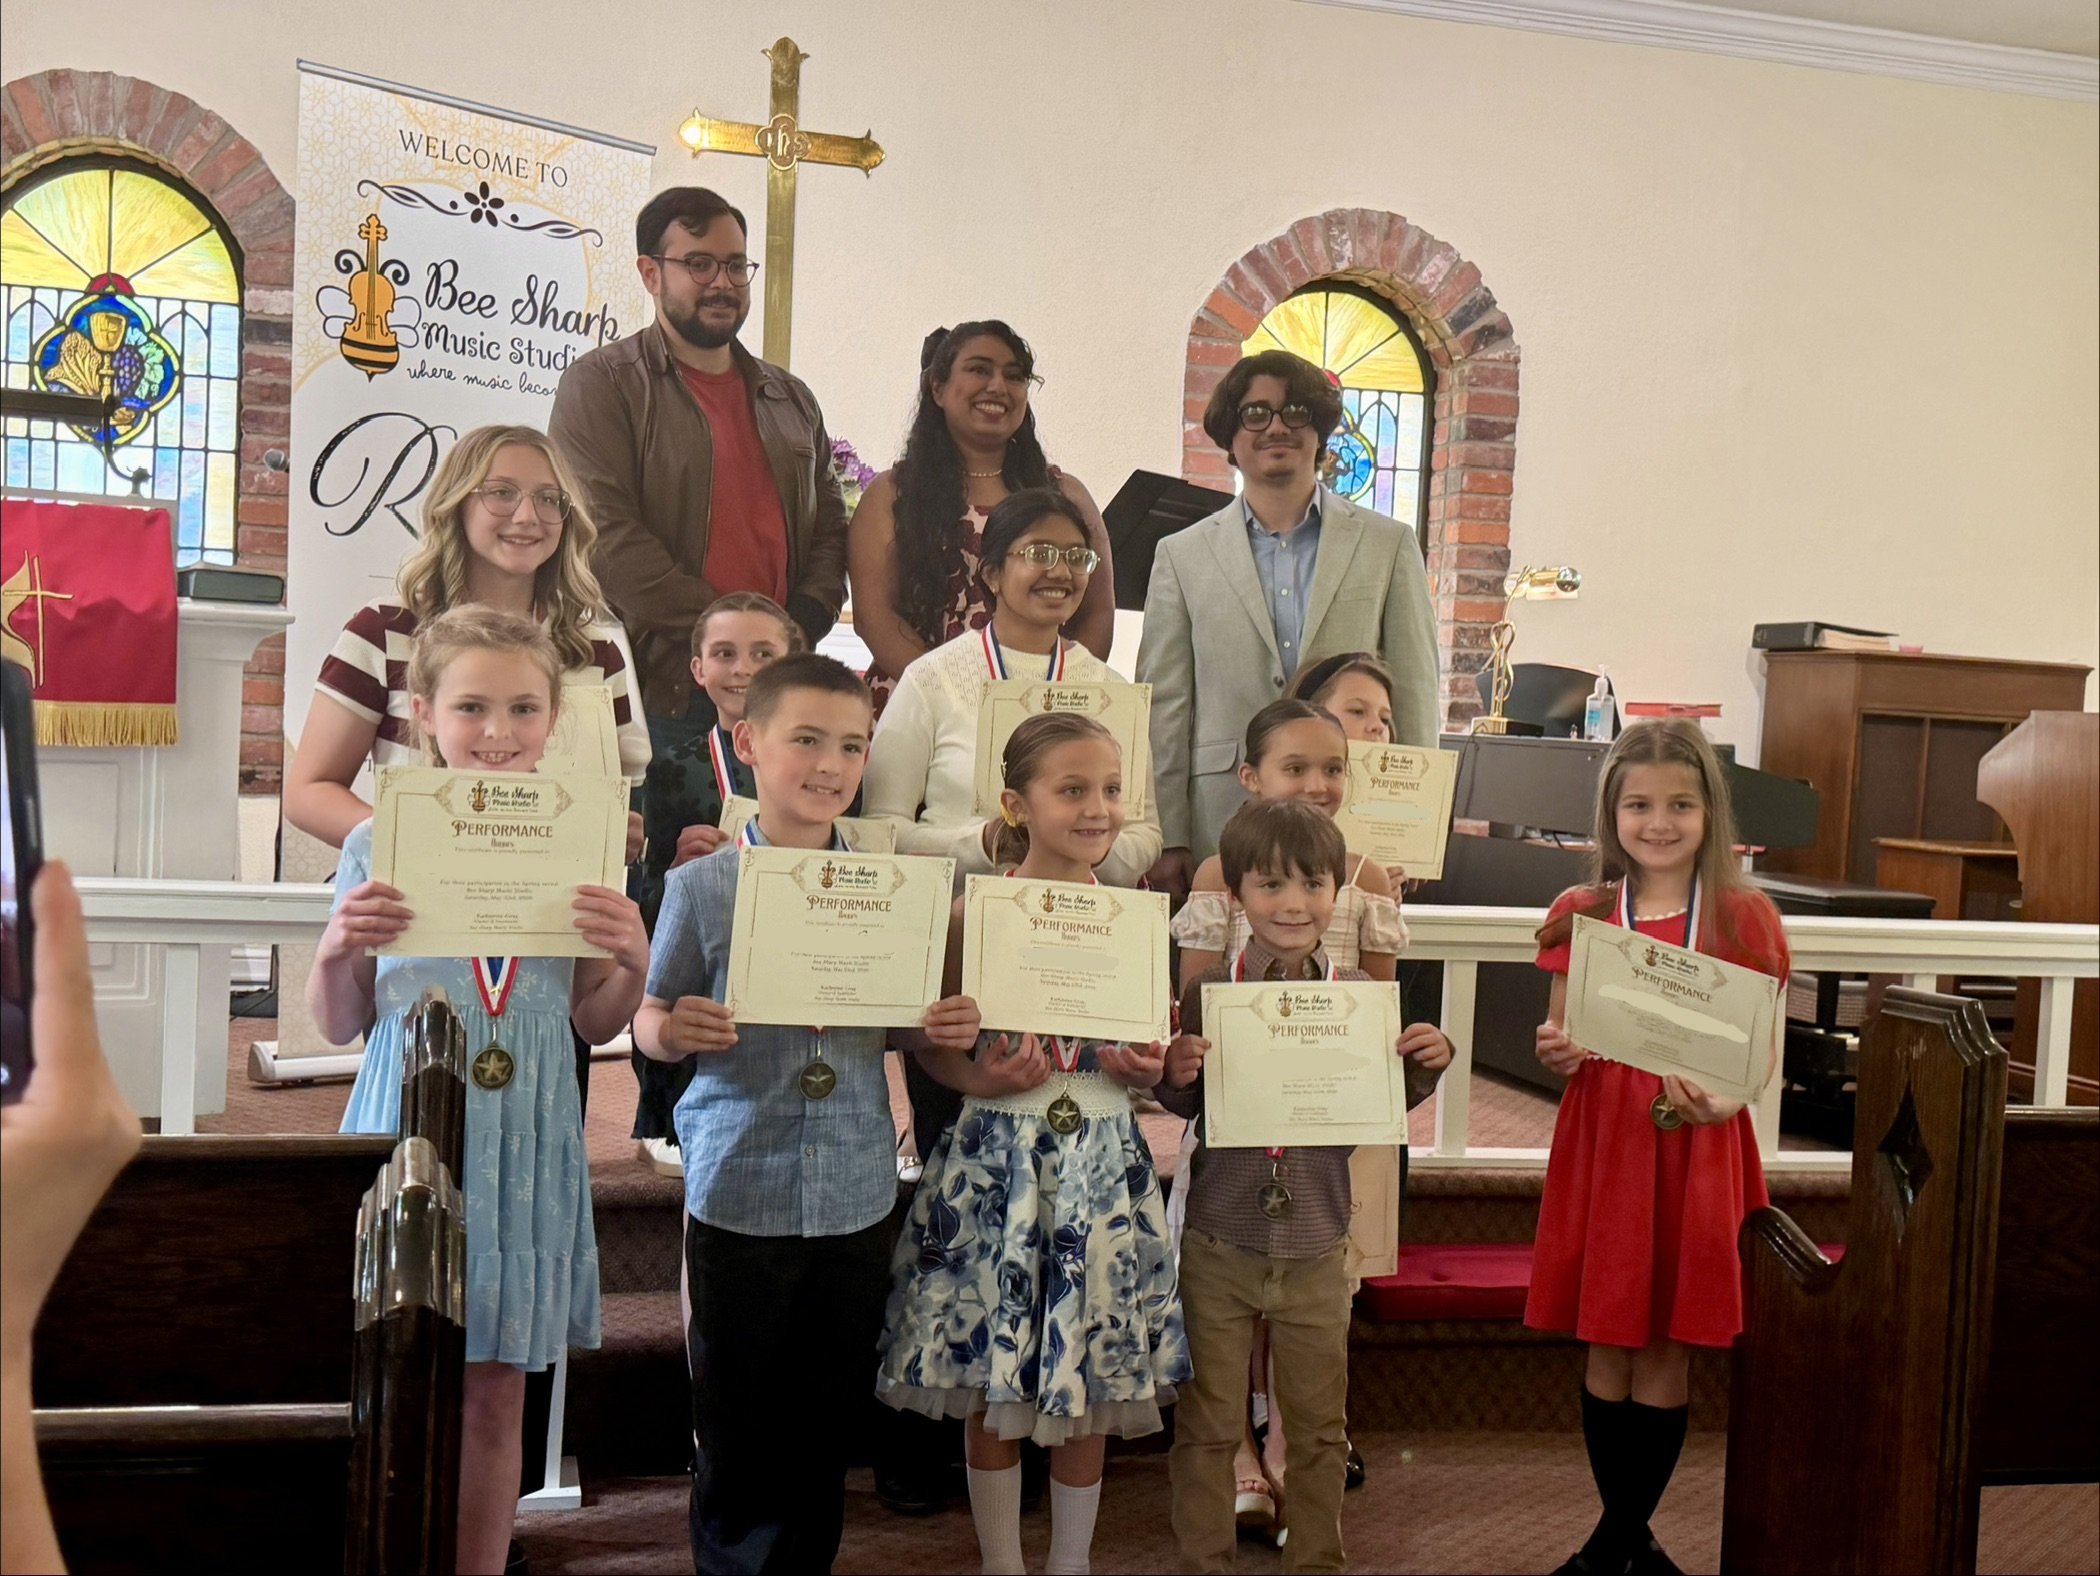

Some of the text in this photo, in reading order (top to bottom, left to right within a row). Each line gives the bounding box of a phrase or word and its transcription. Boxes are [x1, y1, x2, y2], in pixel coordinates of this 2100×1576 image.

[399, 129, 568, 188] WELCOME TO
[424, 258, 620, 346] Bee Sharp
[422, 322, 501, 361] Music
[407, 360, 456, 382] where
[463, 372, 512, 391] music
[1370, 777, 1421, 791] PERFORMANCE
[451, 820, 553, 838] PERFORMANCE
[806, 894, 892, 912] PERFORMANCE
[1030, 916, 1113, 936] PERFORMANCE
[1631, 966, 1713, 1003] PERFORMANCE
[1267, 1023, 1349, 1039] PERFORMANCE
